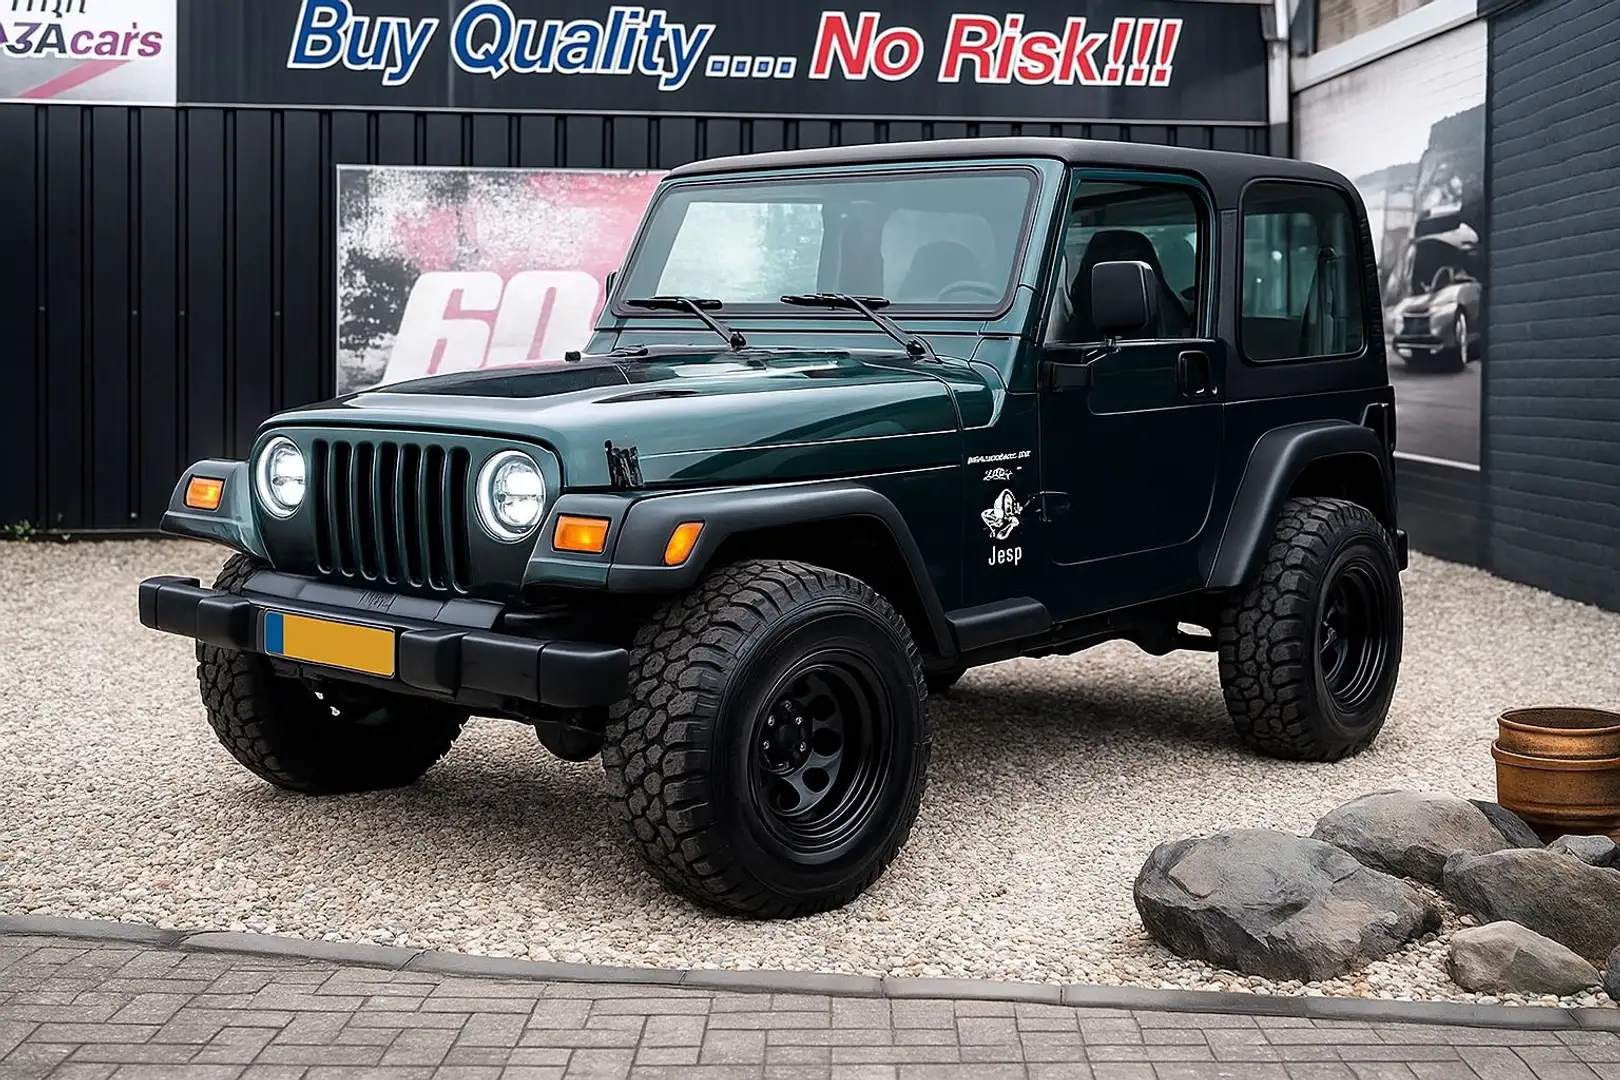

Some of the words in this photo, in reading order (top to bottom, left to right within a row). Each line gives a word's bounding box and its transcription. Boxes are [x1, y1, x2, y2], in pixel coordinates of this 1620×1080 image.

[287, 0, 440, 86] Buy
[808, 11, 924, 82] No
[937, 13, 1183, 87] Risk!!!
